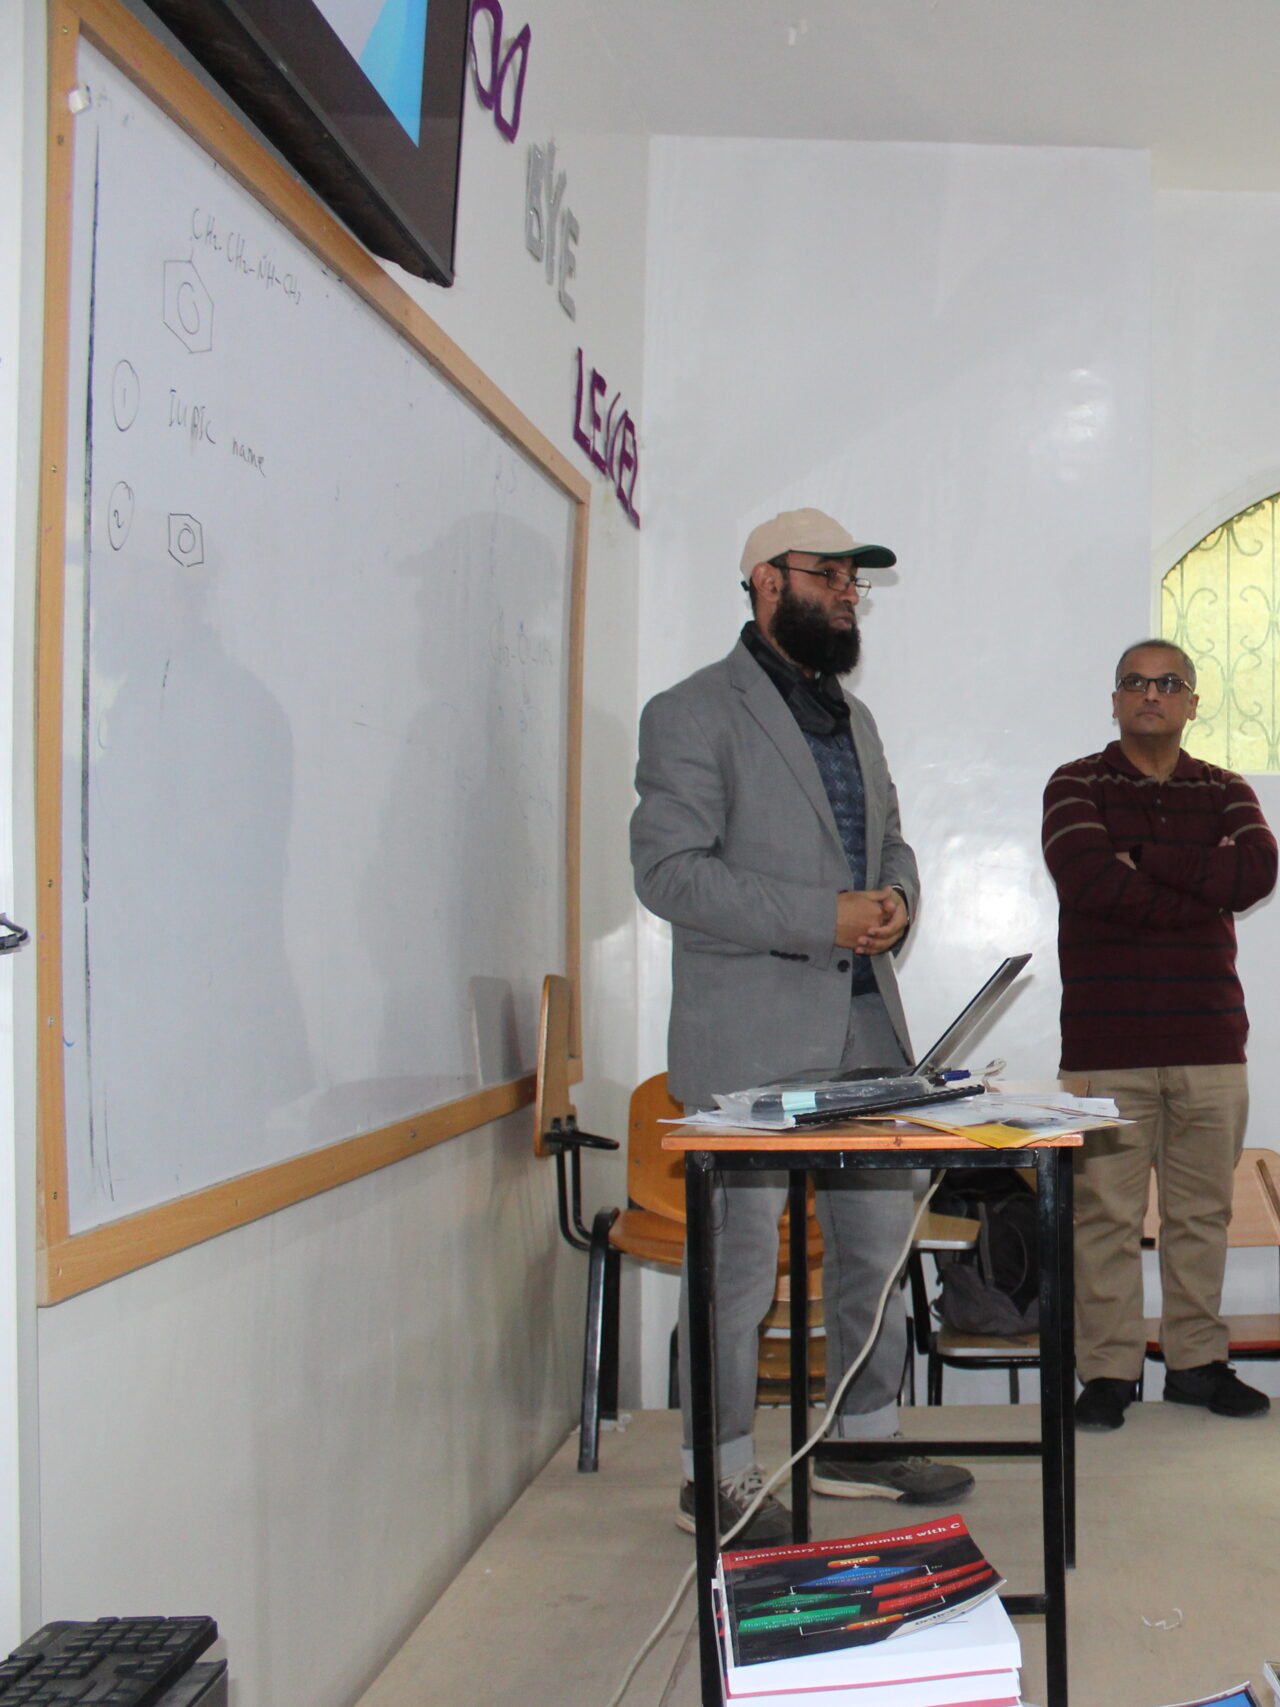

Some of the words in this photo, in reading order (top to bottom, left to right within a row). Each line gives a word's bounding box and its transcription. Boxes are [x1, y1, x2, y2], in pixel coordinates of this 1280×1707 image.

[525, 138, 580, 323] BYE
[735, 1547, 815, 1562] Elementary
[820, 1534, 913, 1551] Programming
[916, 1527, 947, 1538] with
[839, 1557, 869, 1565] Start
